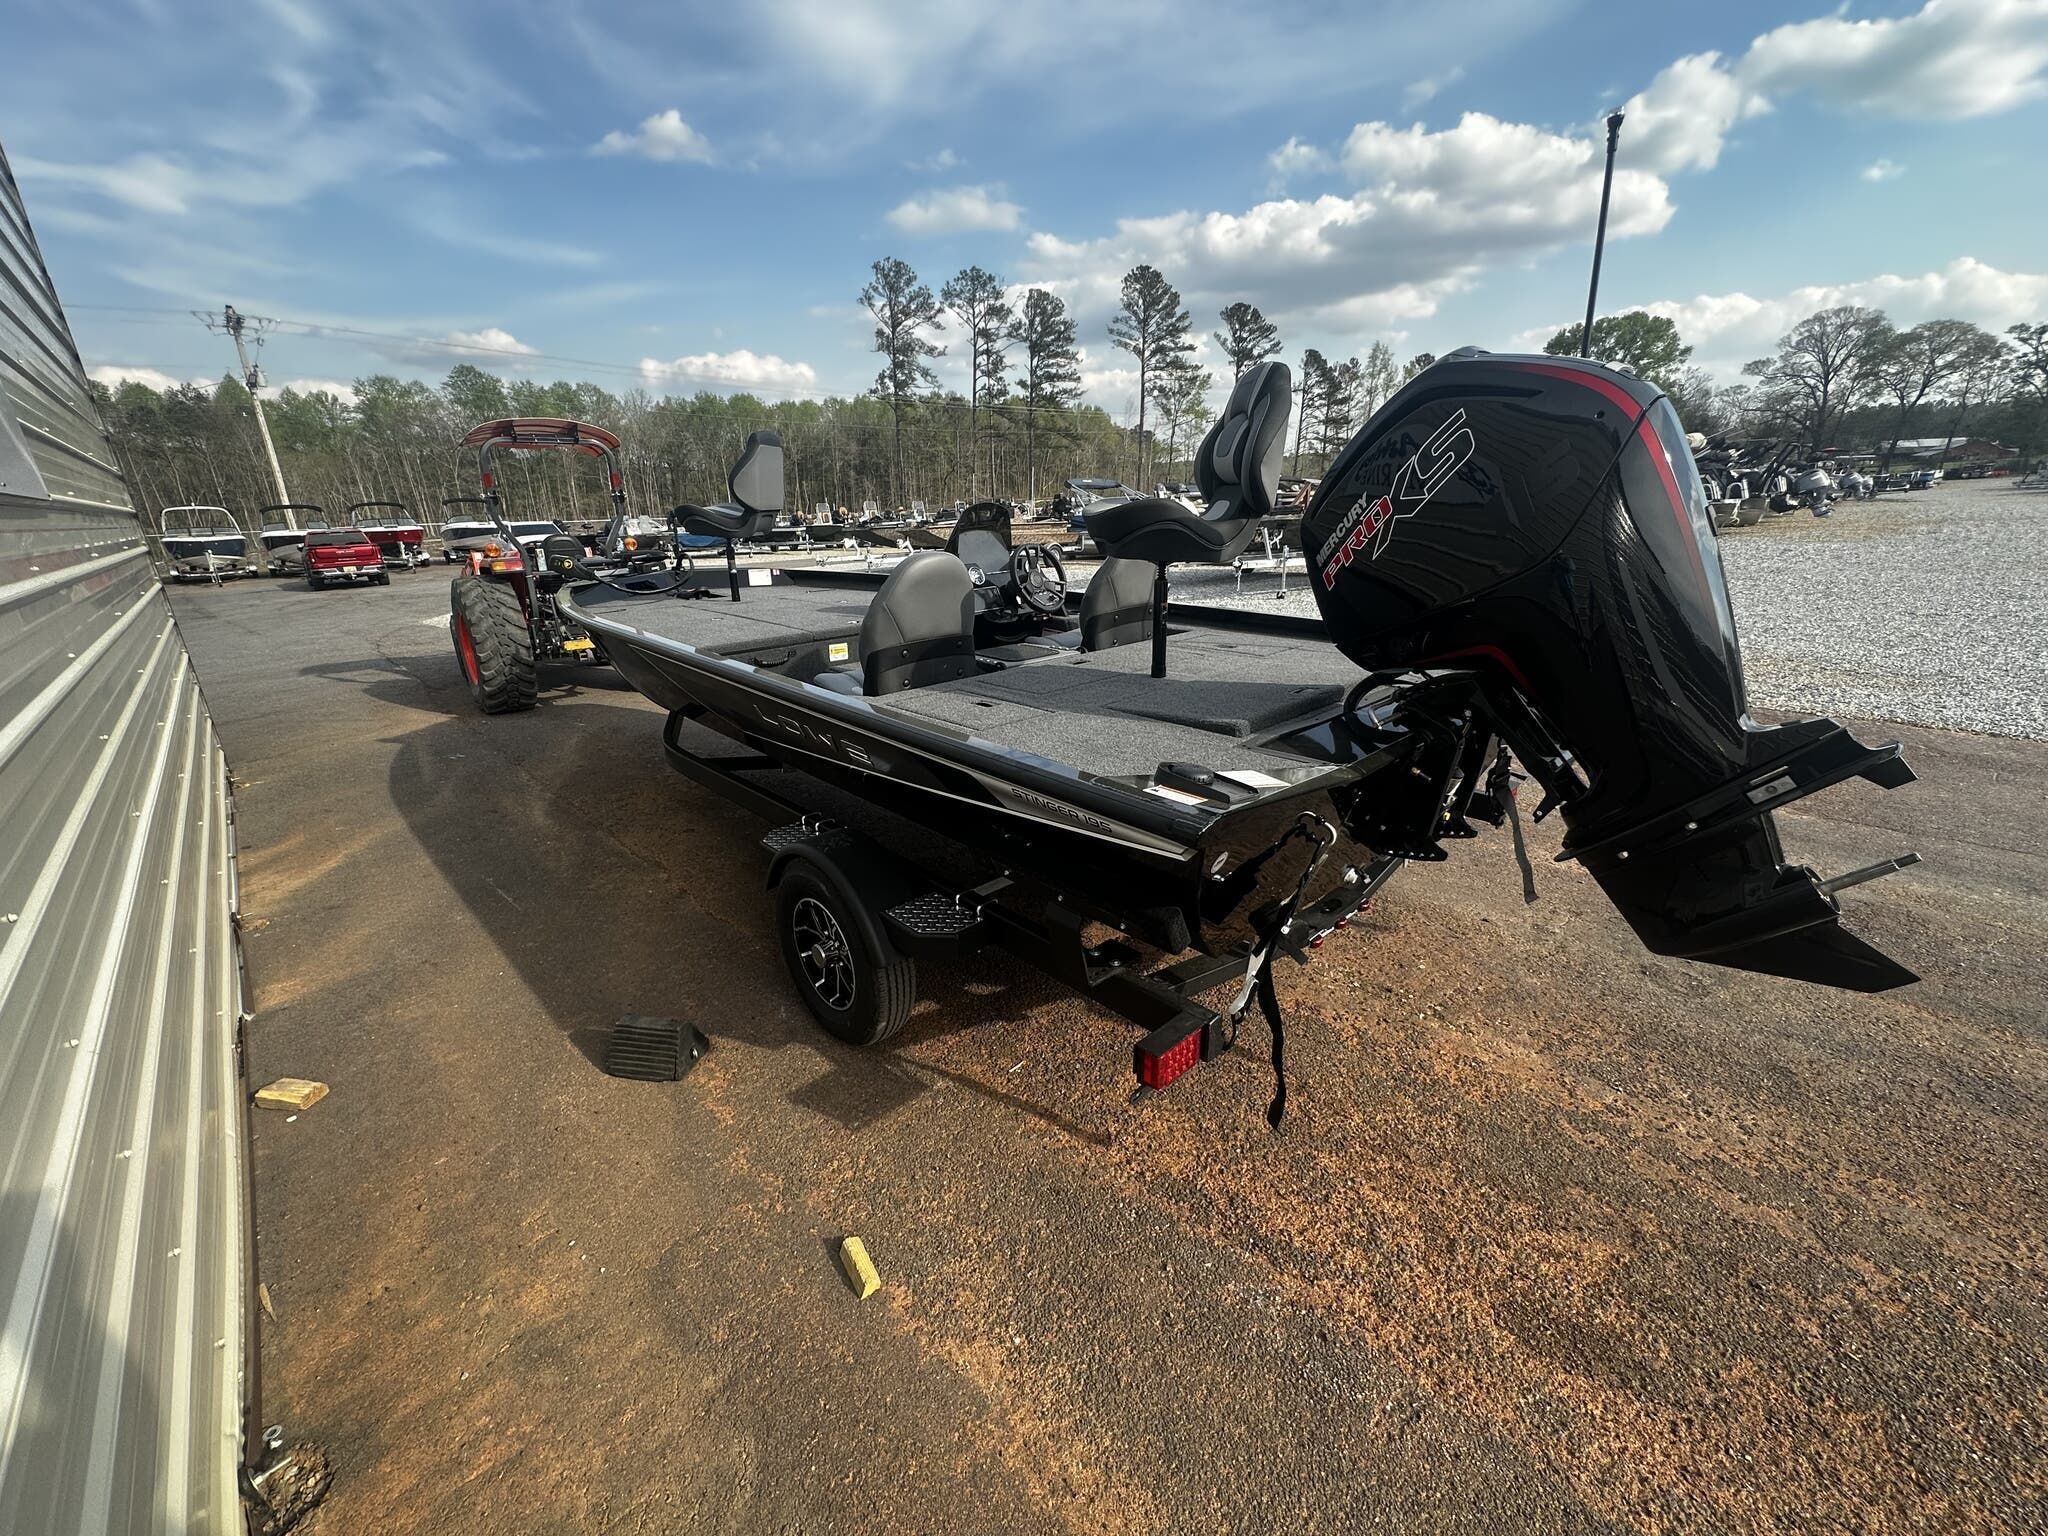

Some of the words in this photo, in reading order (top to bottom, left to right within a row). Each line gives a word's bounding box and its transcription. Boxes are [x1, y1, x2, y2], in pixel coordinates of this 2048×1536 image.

[1315, 492, 1368, 567] MERCURY
[1322, 495, 1393, 591] PRO
[1372, 407, 1475, 560] XS
[1011, 788, 1080, 822] STINGER
[1082, 814, 1112, 833] 195
